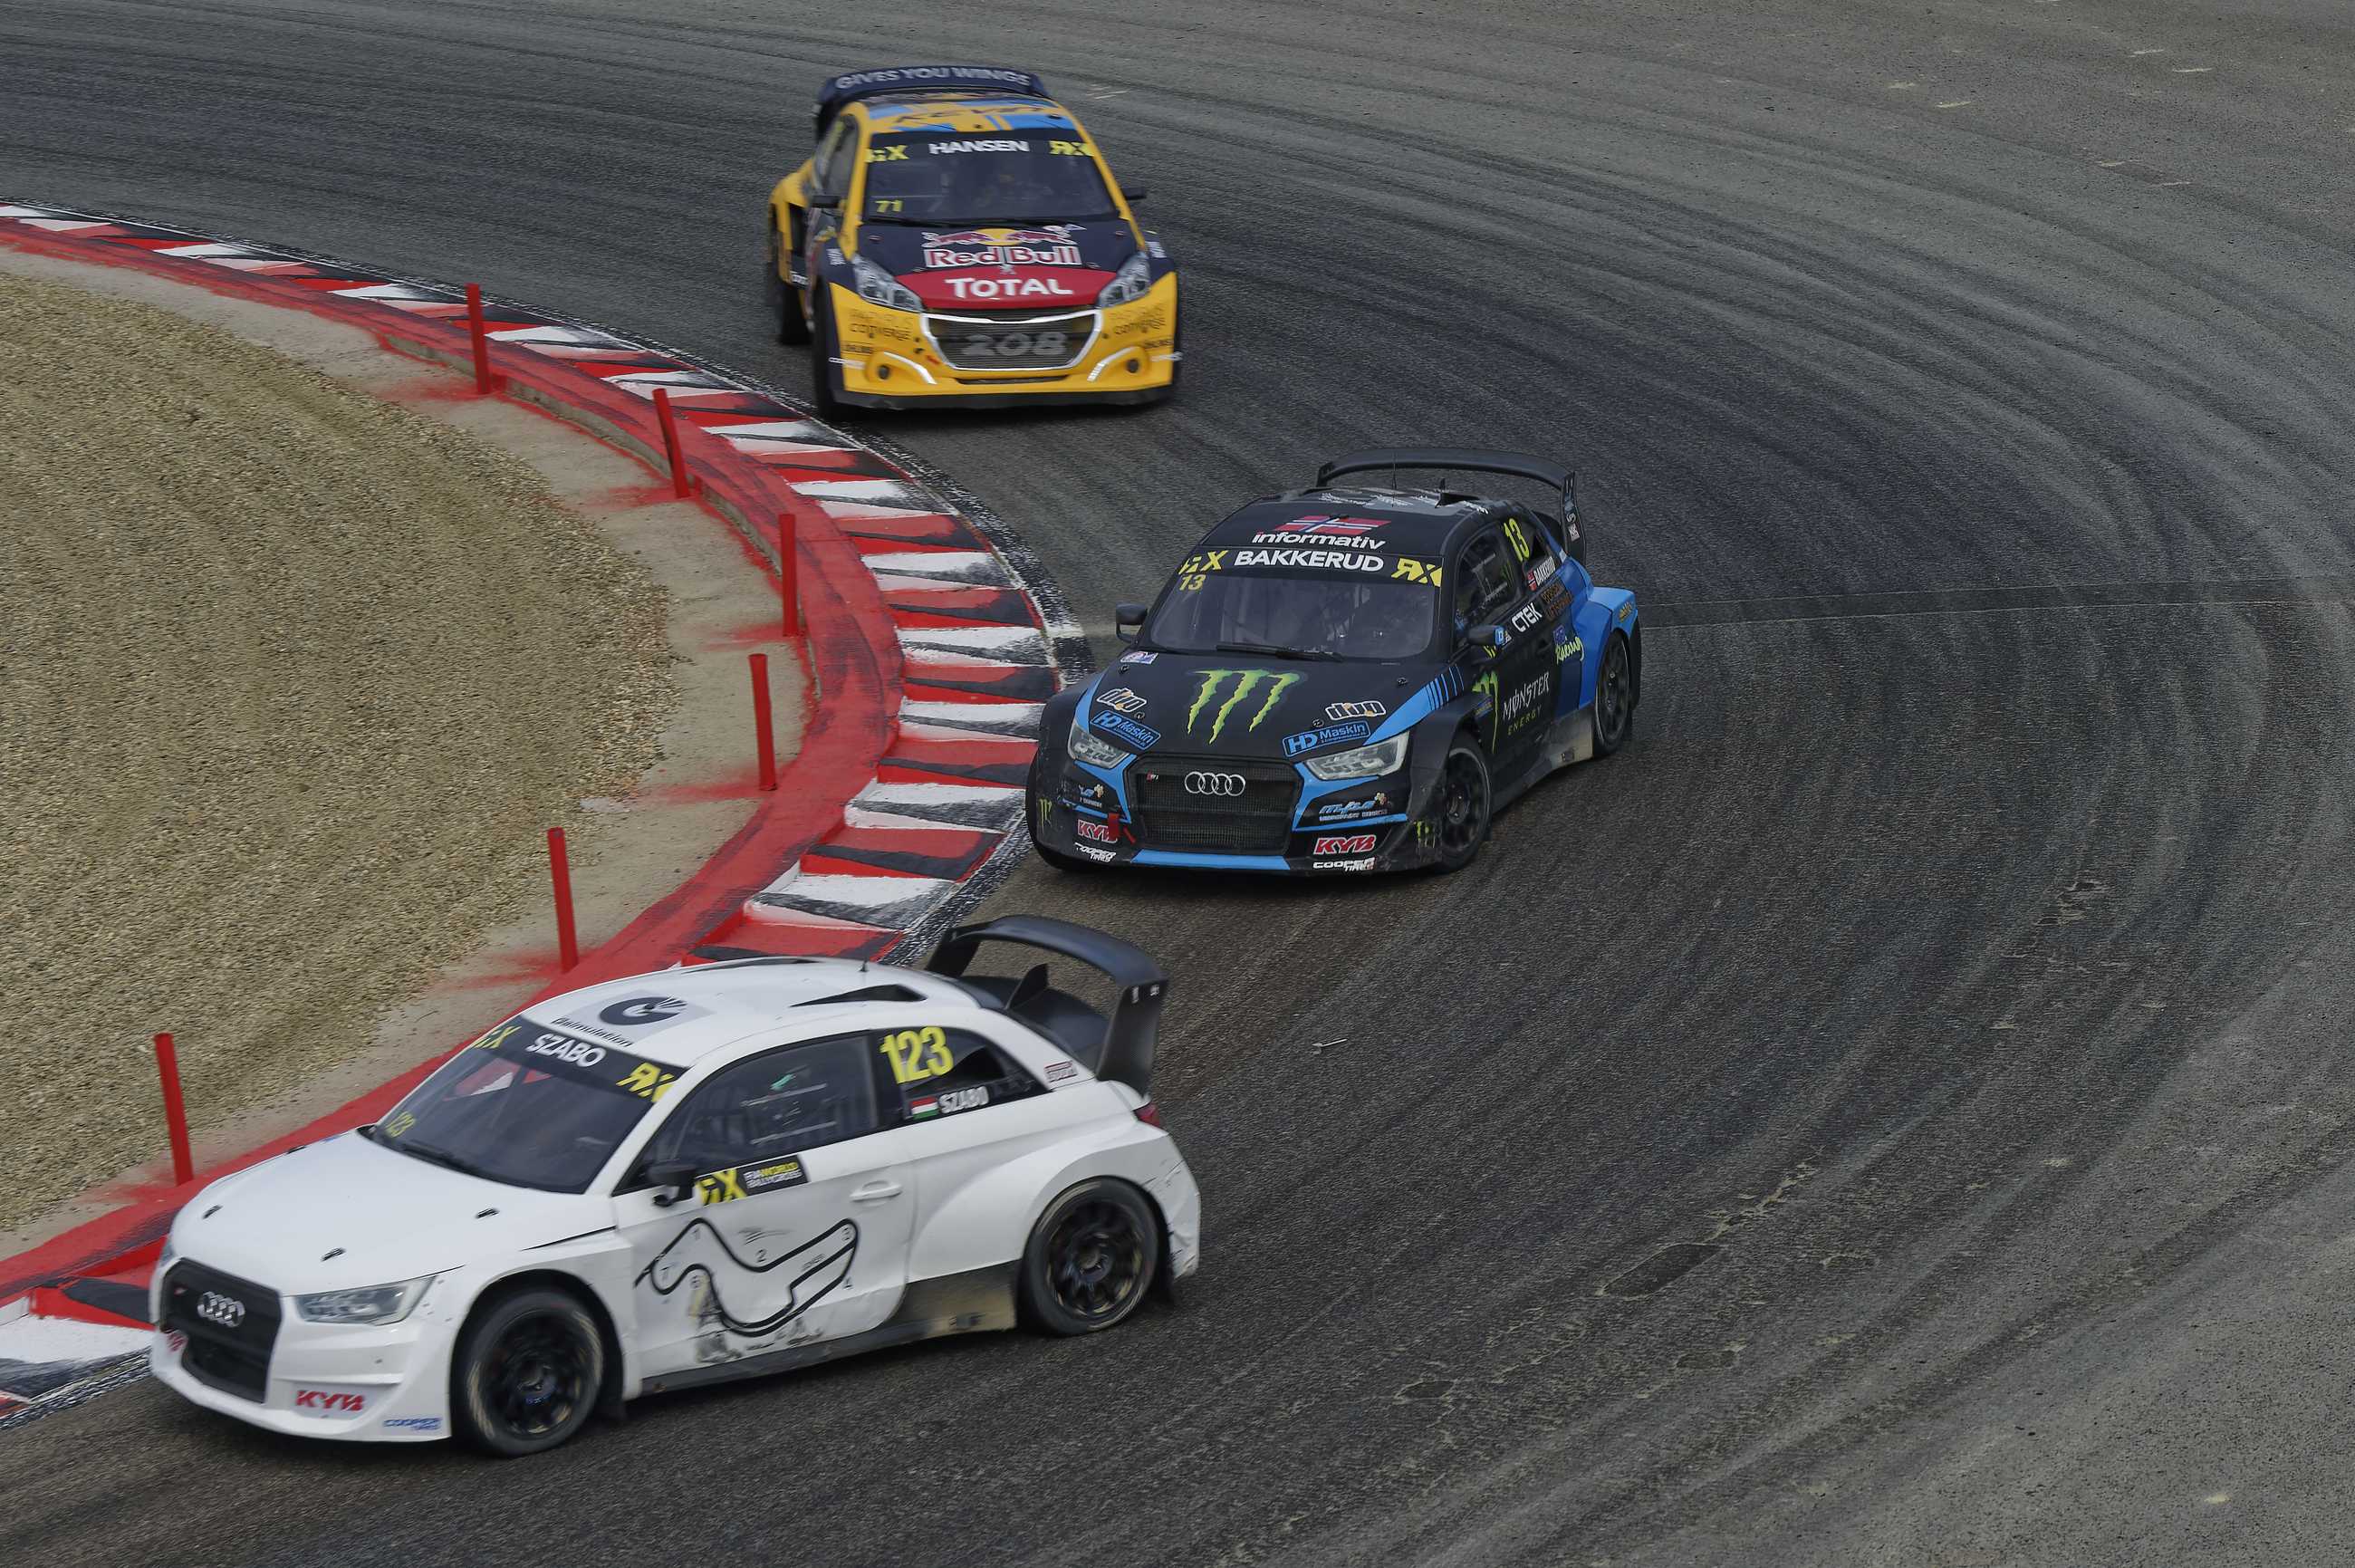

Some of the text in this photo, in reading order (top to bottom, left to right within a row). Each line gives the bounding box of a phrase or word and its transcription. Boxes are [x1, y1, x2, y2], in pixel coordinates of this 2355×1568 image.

[834, 66, 1033, 89] GIVES YOU WINGS
[927, 139, 1031, 155] HANSEN
[874, 198, 904, 214] 71
[924, 245, 1082, 267] Red Bull
[945, 276, 1074, 300] TOTAL
[960, 332, 1069, 357] 208
[1252, 531, 1387, 551] informativ
[1503, 517, 1530, 563] 13
[1233, 549, 1386, 572] BAKKERUD
[1179, 573, 1206, 591] 13
[1511, 601, 1543, 633] CTEK
[1117, 719, 1155, 744] Maskin
[1287, 732, 1320, 755] HD
[1319, 722, 1366, 740] Maskin
[1312, 833, 1377, 855] KYB
[525, 1034, 608, 1069] SZABO
[879, 1025, 954, 1084] 123
[294, 1390, 365, 1412] KYB
